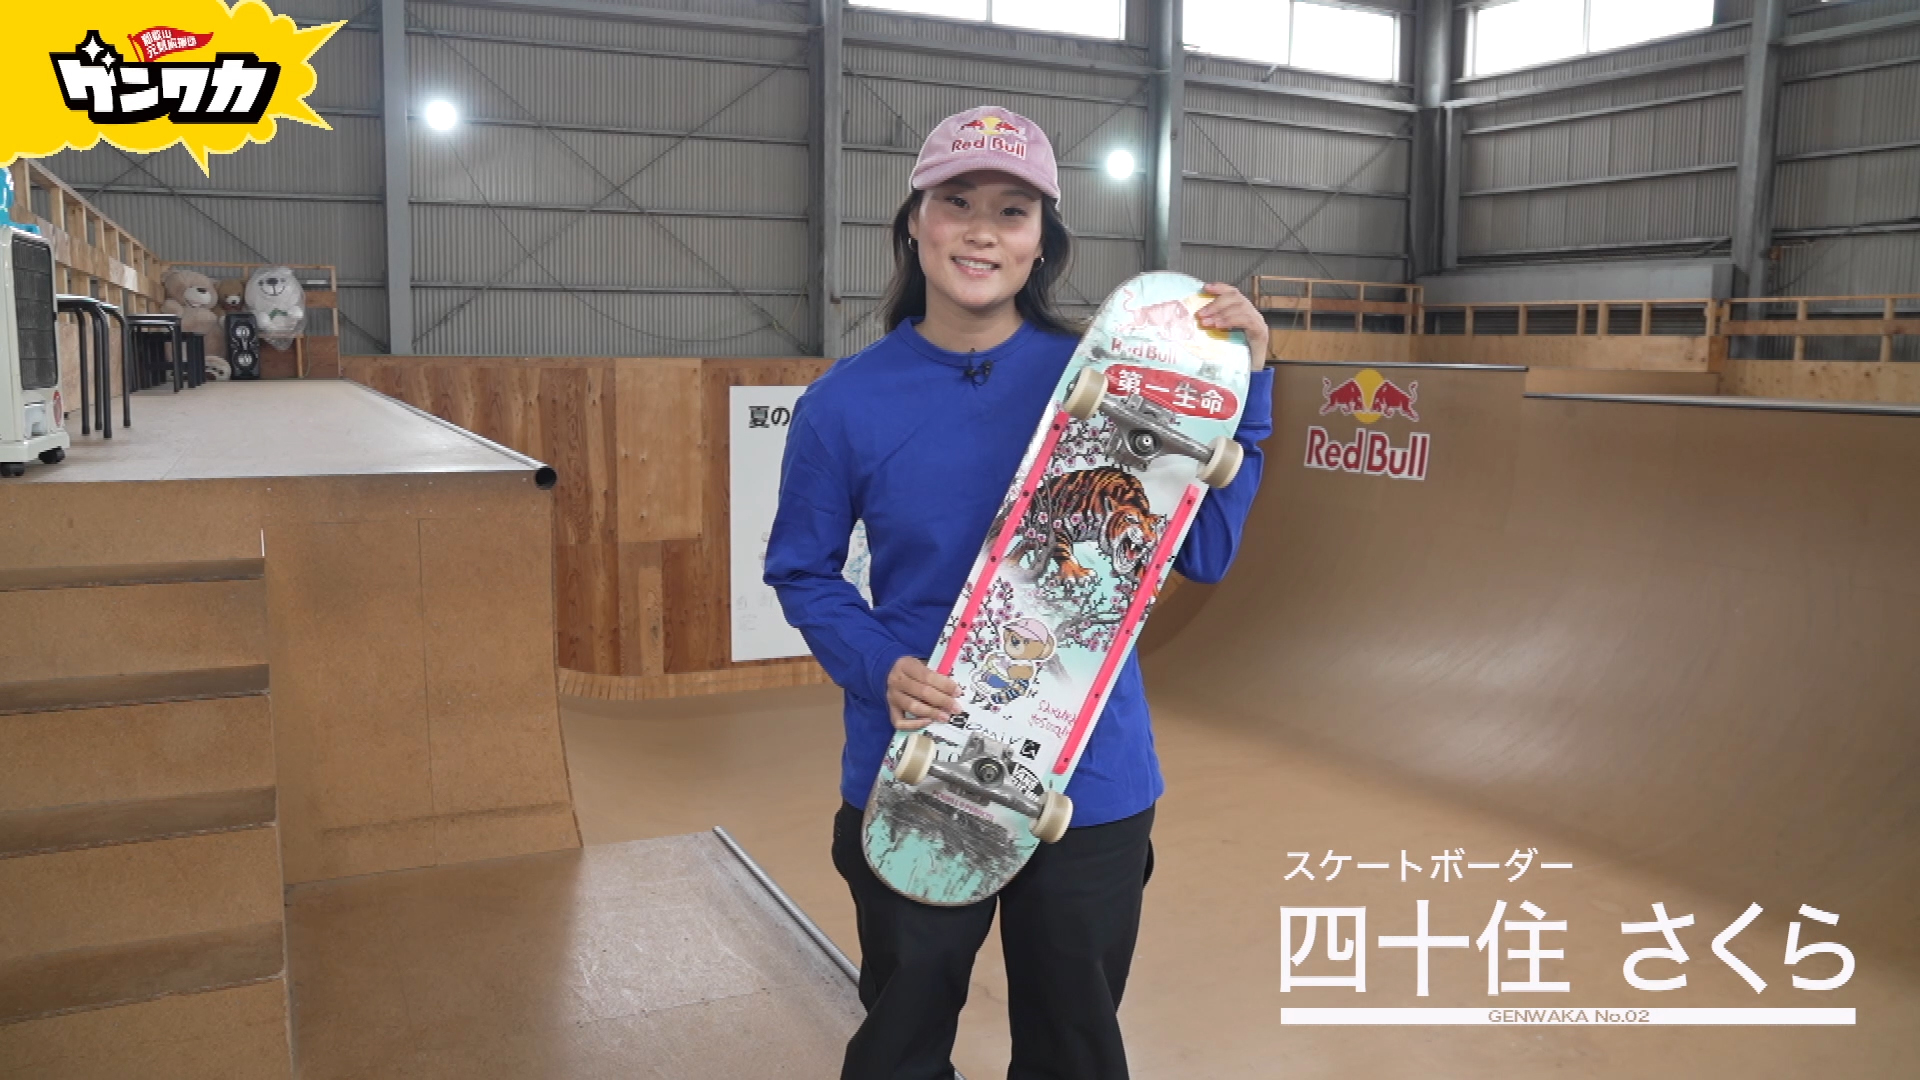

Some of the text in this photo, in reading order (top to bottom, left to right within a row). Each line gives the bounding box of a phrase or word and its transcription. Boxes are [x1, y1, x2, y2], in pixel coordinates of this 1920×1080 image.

[951, 135, 1027, 158] Red Bull
[1146, 345, 1177, 364] Bull
[1116, 369, 1225, 415] 第一生命
[748, 405, 791, 428] 夏の
[1305, 428, 1428, 477] Red Bull
